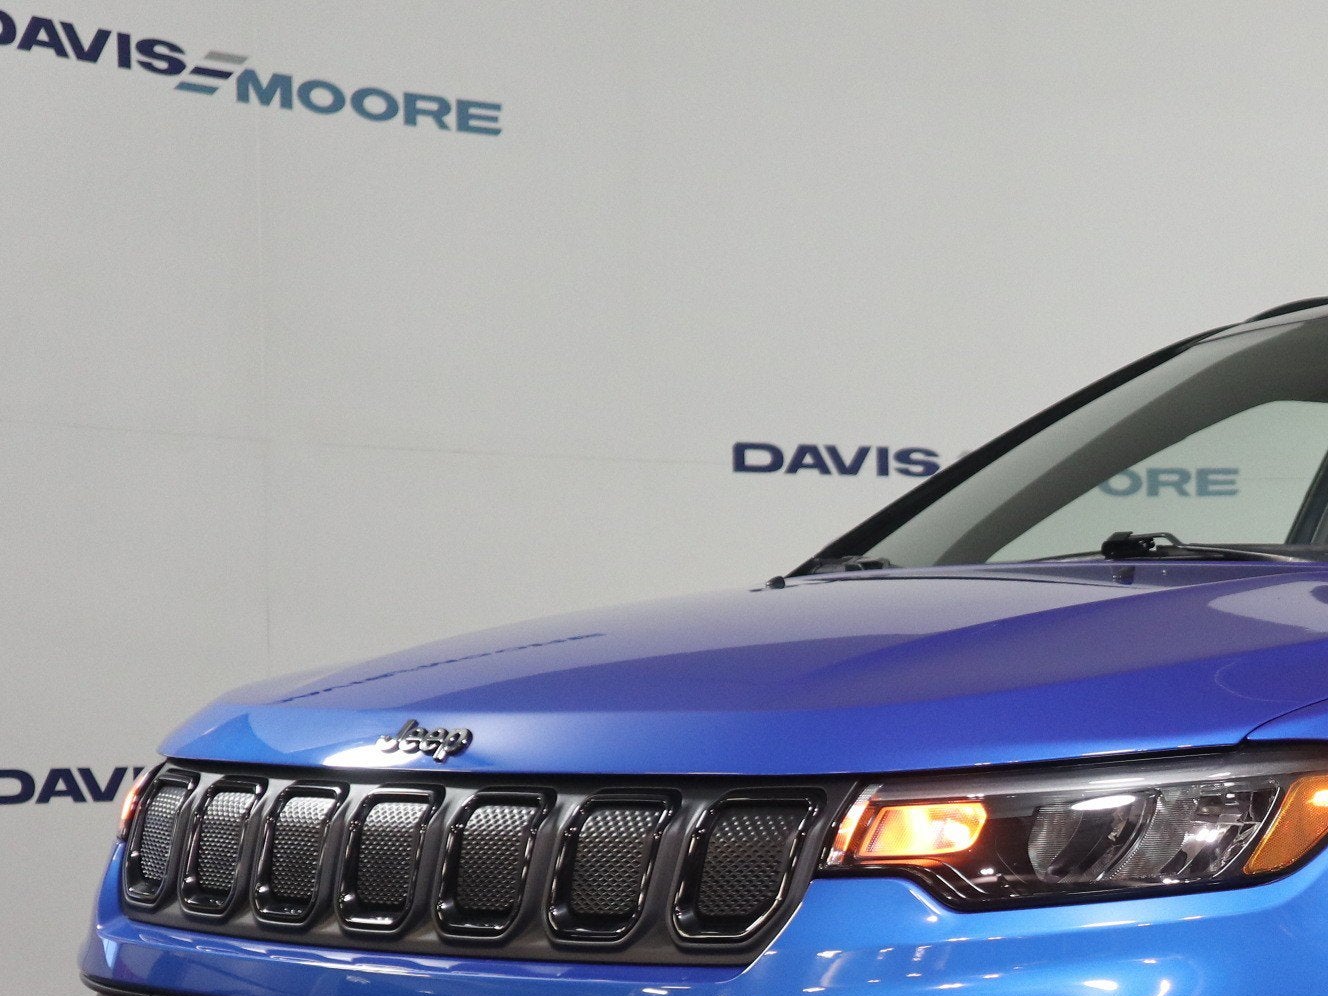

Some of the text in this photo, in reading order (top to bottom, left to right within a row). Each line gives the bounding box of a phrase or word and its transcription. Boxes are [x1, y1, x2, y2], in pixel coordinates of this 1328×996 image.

[236, 69, 502, 136] MOORE
[732, 442, 1239, 497] DAVIS ORE
[376, 719, 473, 763] Jeep
[0, 766, 145, 805] DAV
